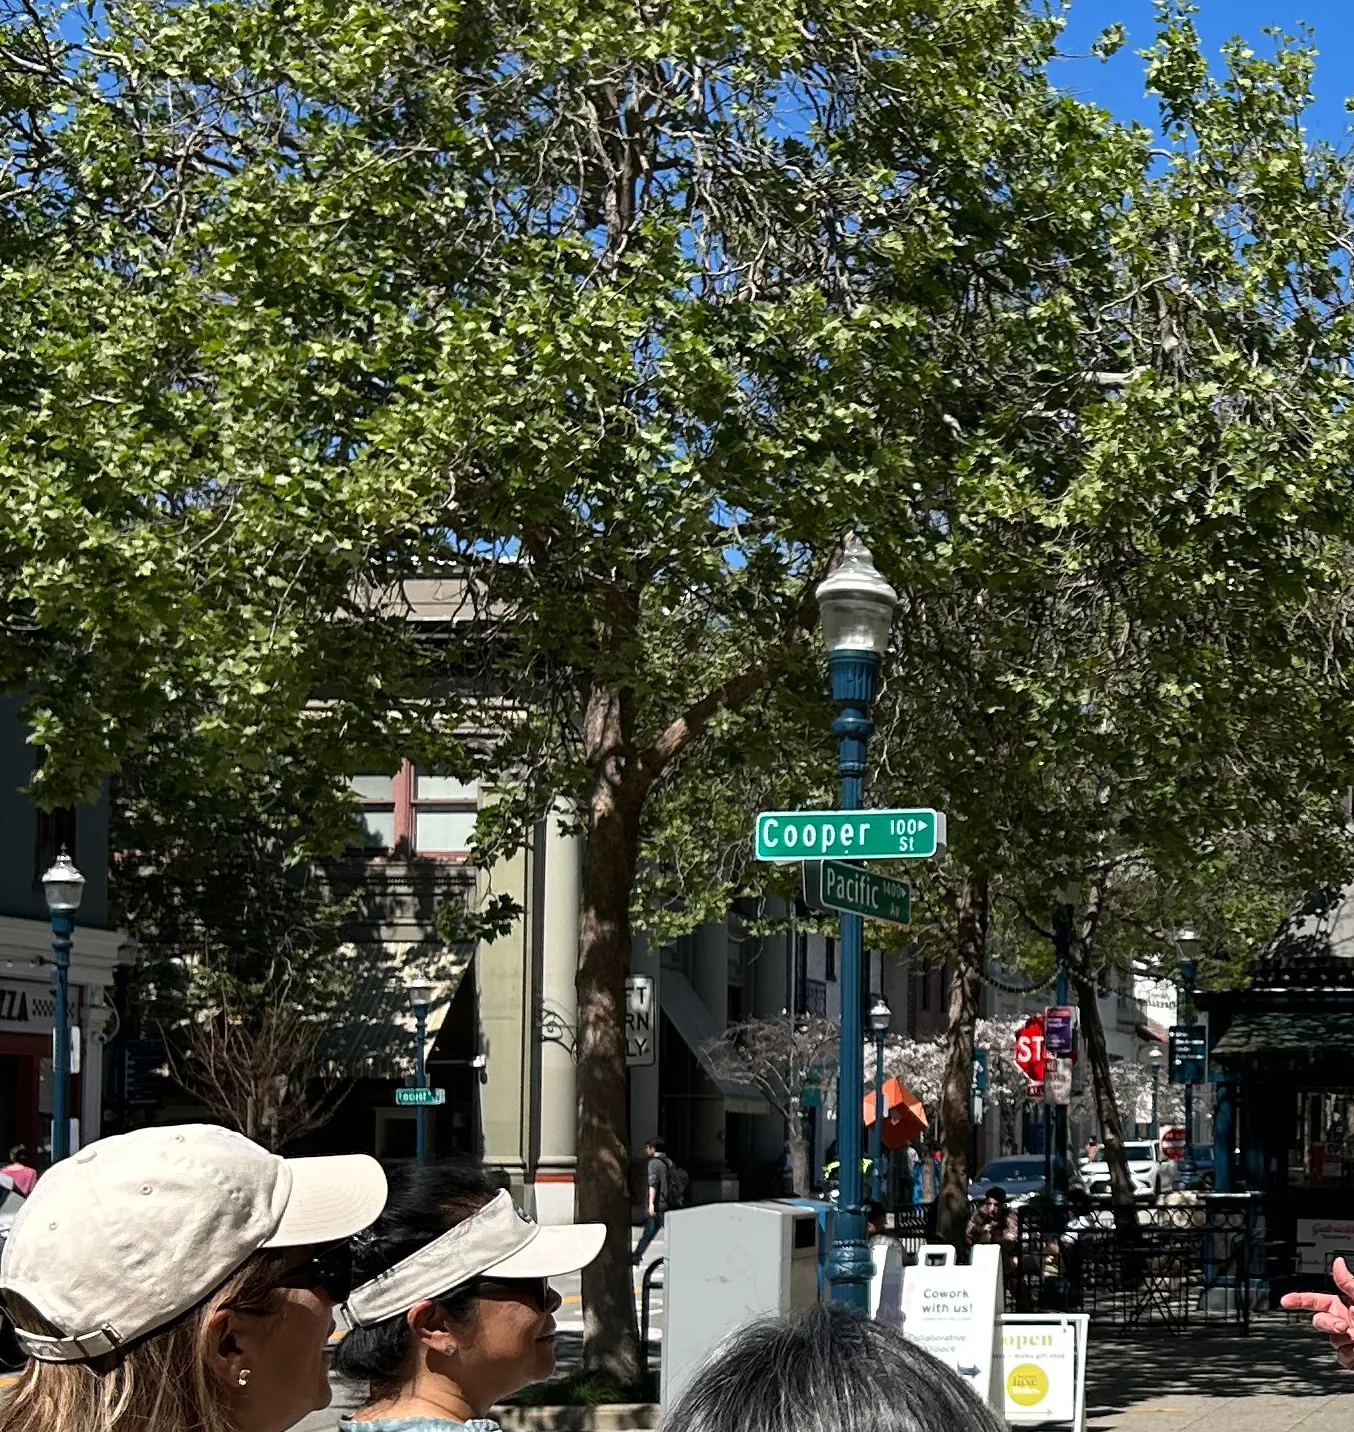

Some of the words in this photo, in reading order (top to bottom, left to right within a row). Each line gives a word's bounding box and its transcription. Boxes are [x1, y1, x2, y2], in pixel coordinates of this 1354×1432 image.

[763, 818, 871, 853] Cooper
[890, 819, 917, 836] 100
[900, 836, 915, 852] St
[826, 868, 879, 910] Pacific
[890, 901, 900, 919] Av
[1018, 1036, 1045, 1062] ST
[923, 1288, 969, 1299] Cowork
[922, 1303, 949, 1313] with
[954, 1303, 973, 1313] us!
[1000, 1335, 1053, 1350] open
